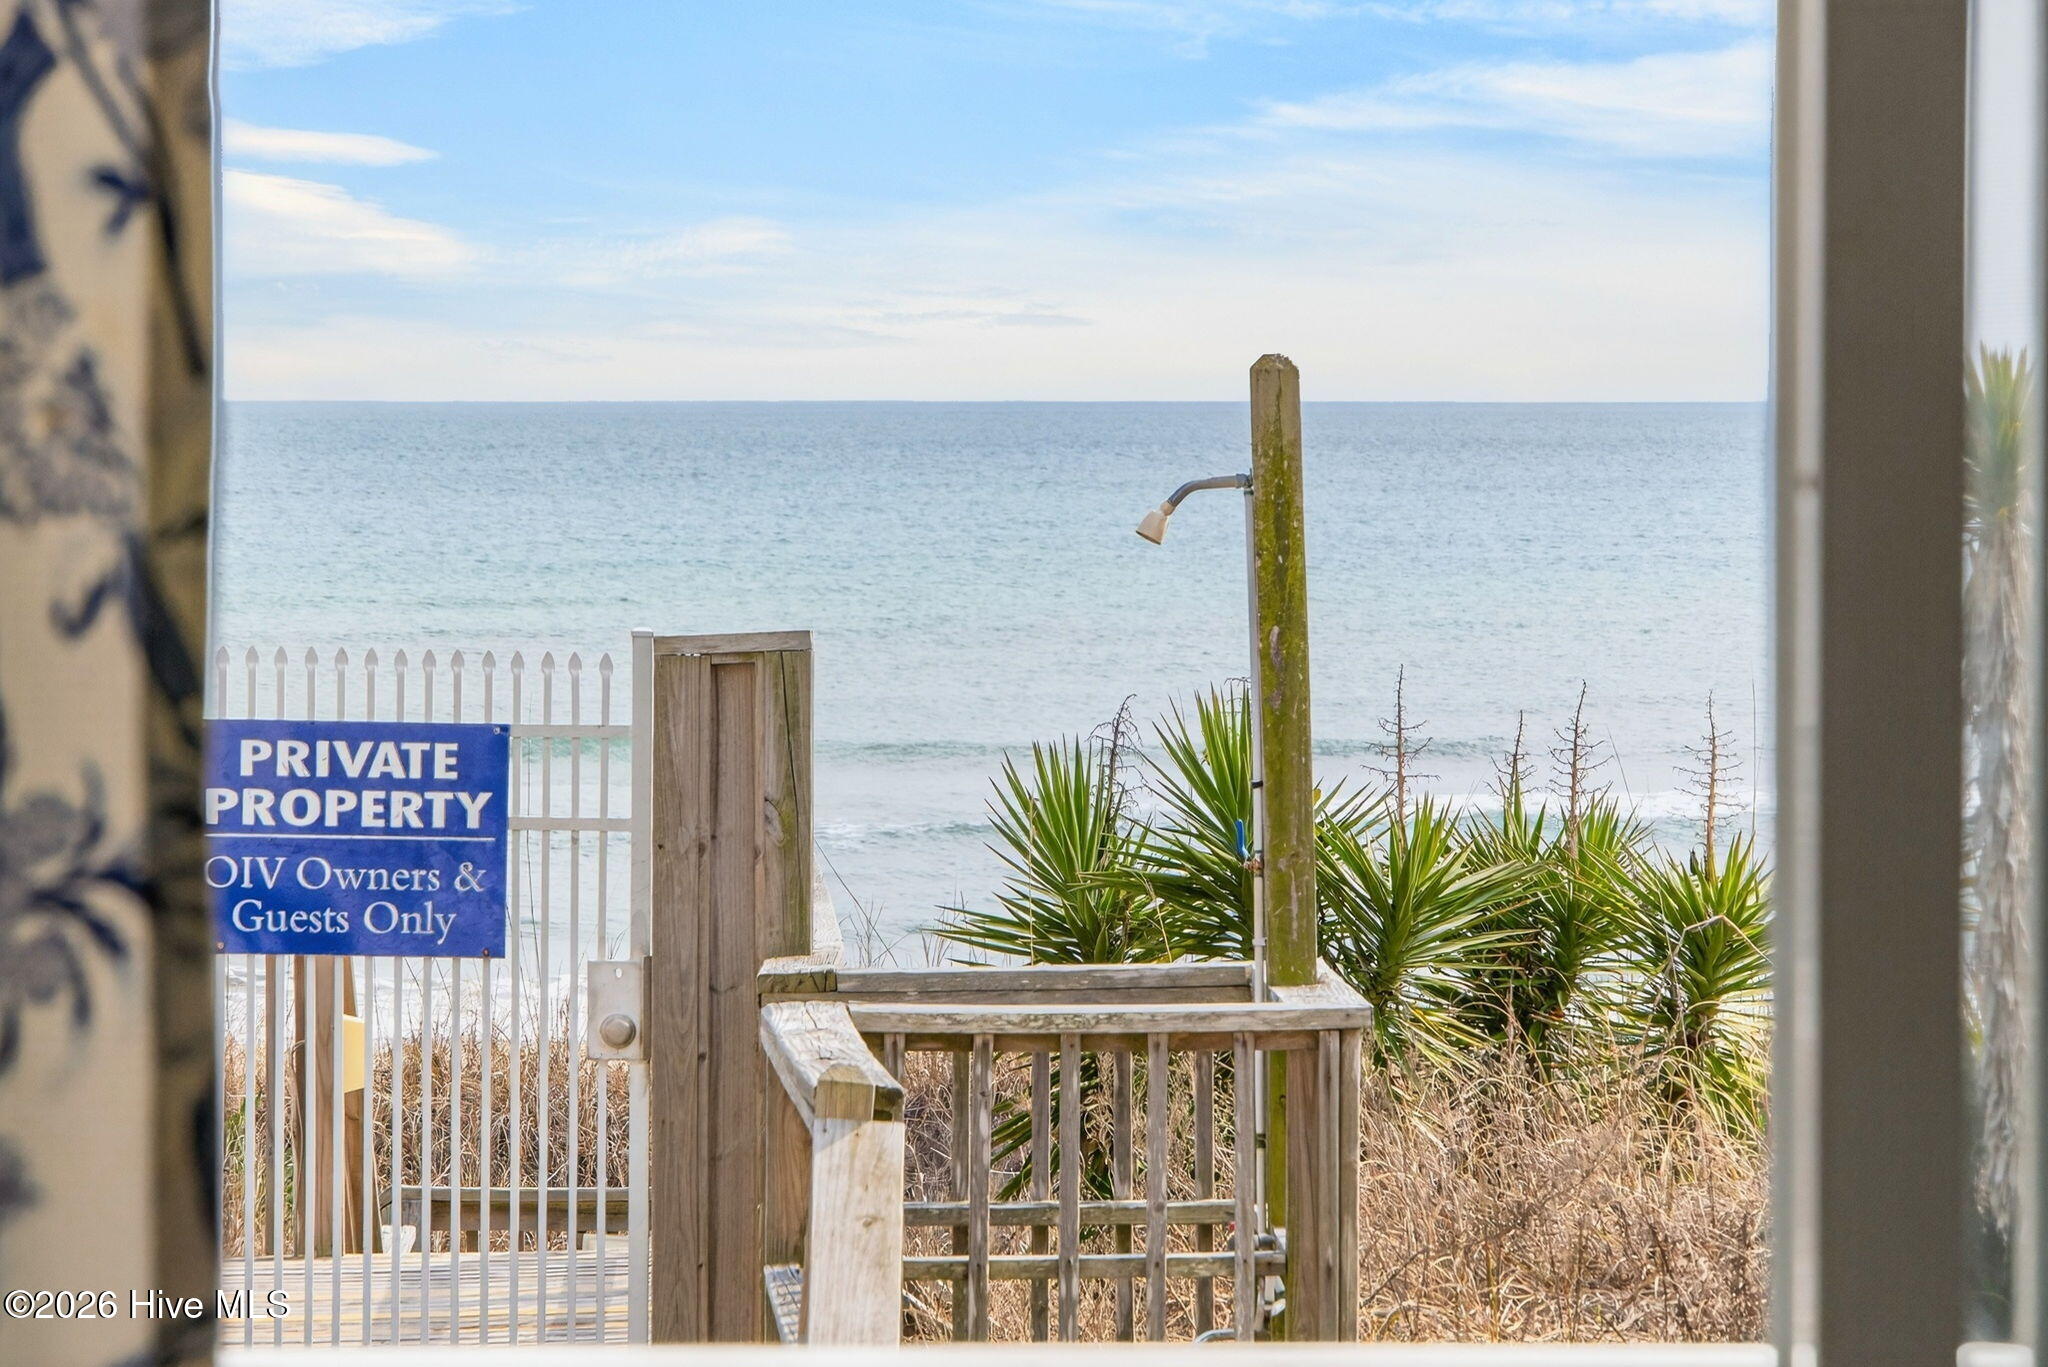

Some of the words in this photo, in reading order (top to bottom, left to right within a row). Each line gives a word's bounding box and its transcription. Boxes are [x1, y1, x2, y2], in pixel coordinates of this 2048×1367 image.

[239, 739, 459, 780] PRIVATE
[205, 787, 493, 829] PROPERTY
[205, 855, 287, 890] OIV
[296, 856, 441, 892] Owners
[454, 861, 487, 893] &
[231, 898, 350, 933] Guests
[363, 900, 457, 945] Only
